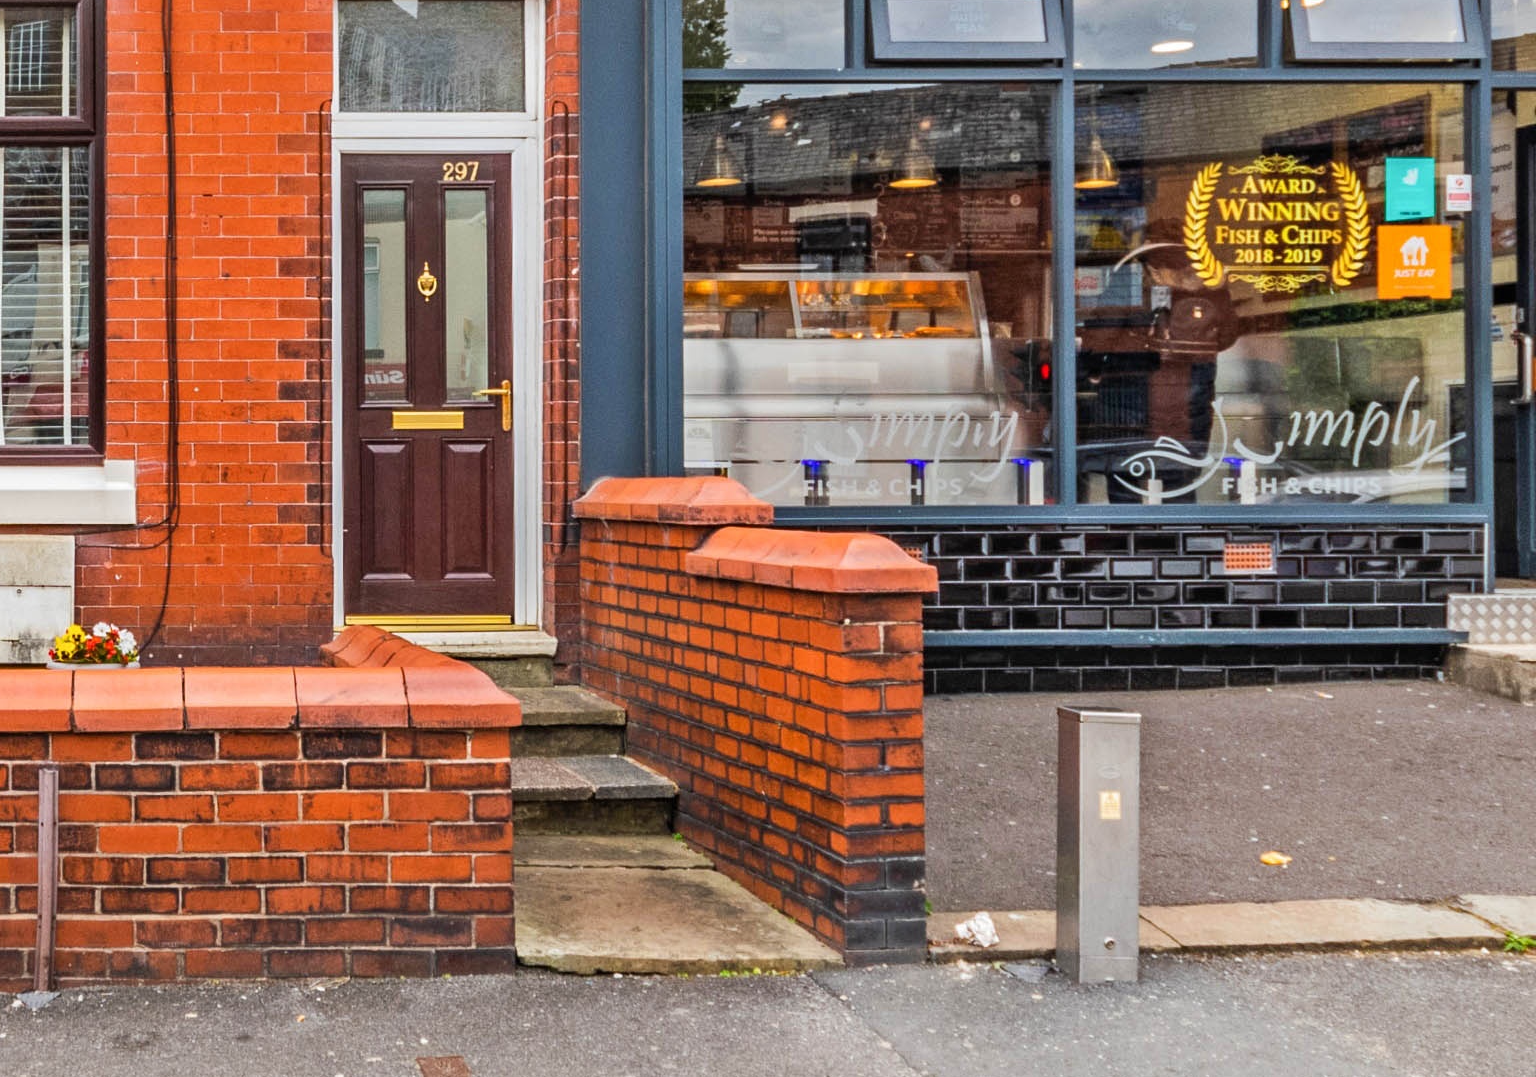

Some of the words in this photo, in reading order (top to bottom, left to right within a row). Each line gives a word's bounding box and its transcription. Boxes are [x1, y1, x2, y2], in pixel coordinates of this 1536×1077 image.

[442, 161, 480, 182] 297
[1241, 175, 1316, 194] AWARD
[1216, 198, 1340, 221] WINNING
[1215, 227, 1260, 245] FISH
[1263, 229, 1279, 245] &
[1281, 225, 1343, 245] CHIPS
[1393, 268, 1416, 279] JUST
[1417, 268, 1436, 278] EAT
[803, 478, 857, 497] FISH
[865, 478, 882, 497] &
[887, 477, 963, 496] CHIPS
[1284, 476, 1302, 495] &
[1308, 476, 1382, 495] CHIPS
